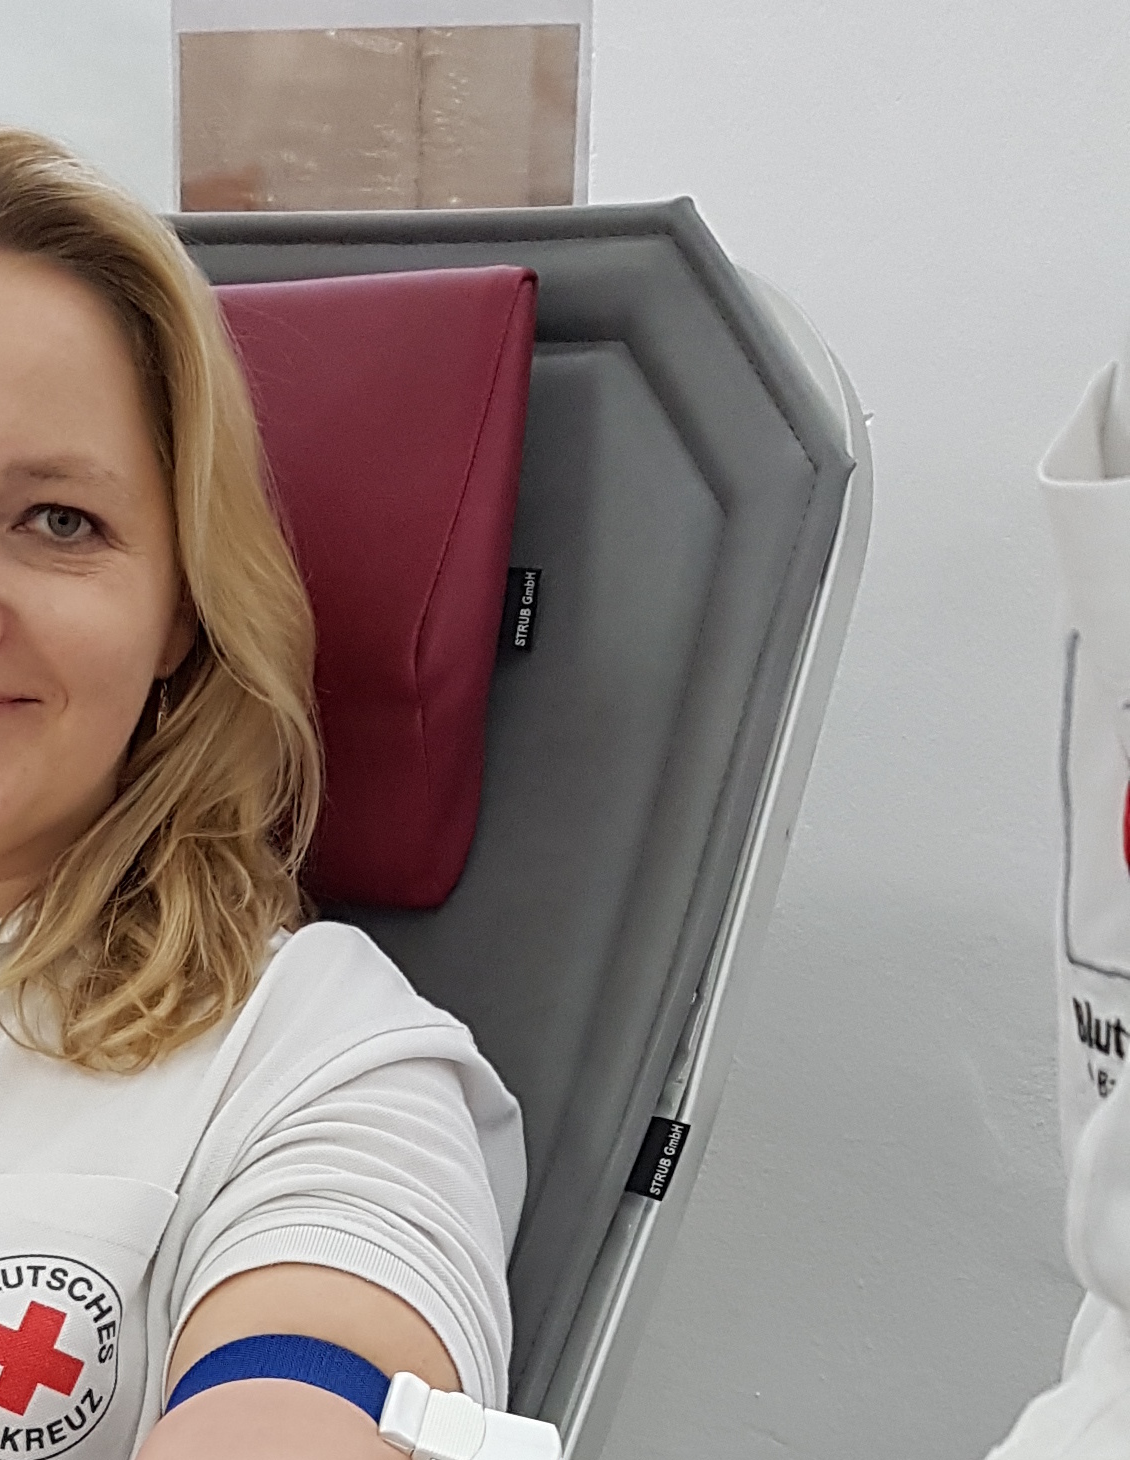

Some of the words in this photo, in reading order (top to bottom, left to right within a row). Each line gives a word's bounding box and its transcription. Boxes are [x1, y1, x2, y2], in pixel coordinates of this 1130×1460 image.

[521, 571, 537, 605] GmbH
[514, 608, 532, 647] STRUB
[649, 1157, 672, 1196] STRUB
[663, 1123, 685, 1156] GmbH
[0, 1388, 103, 1451] KREUZ
